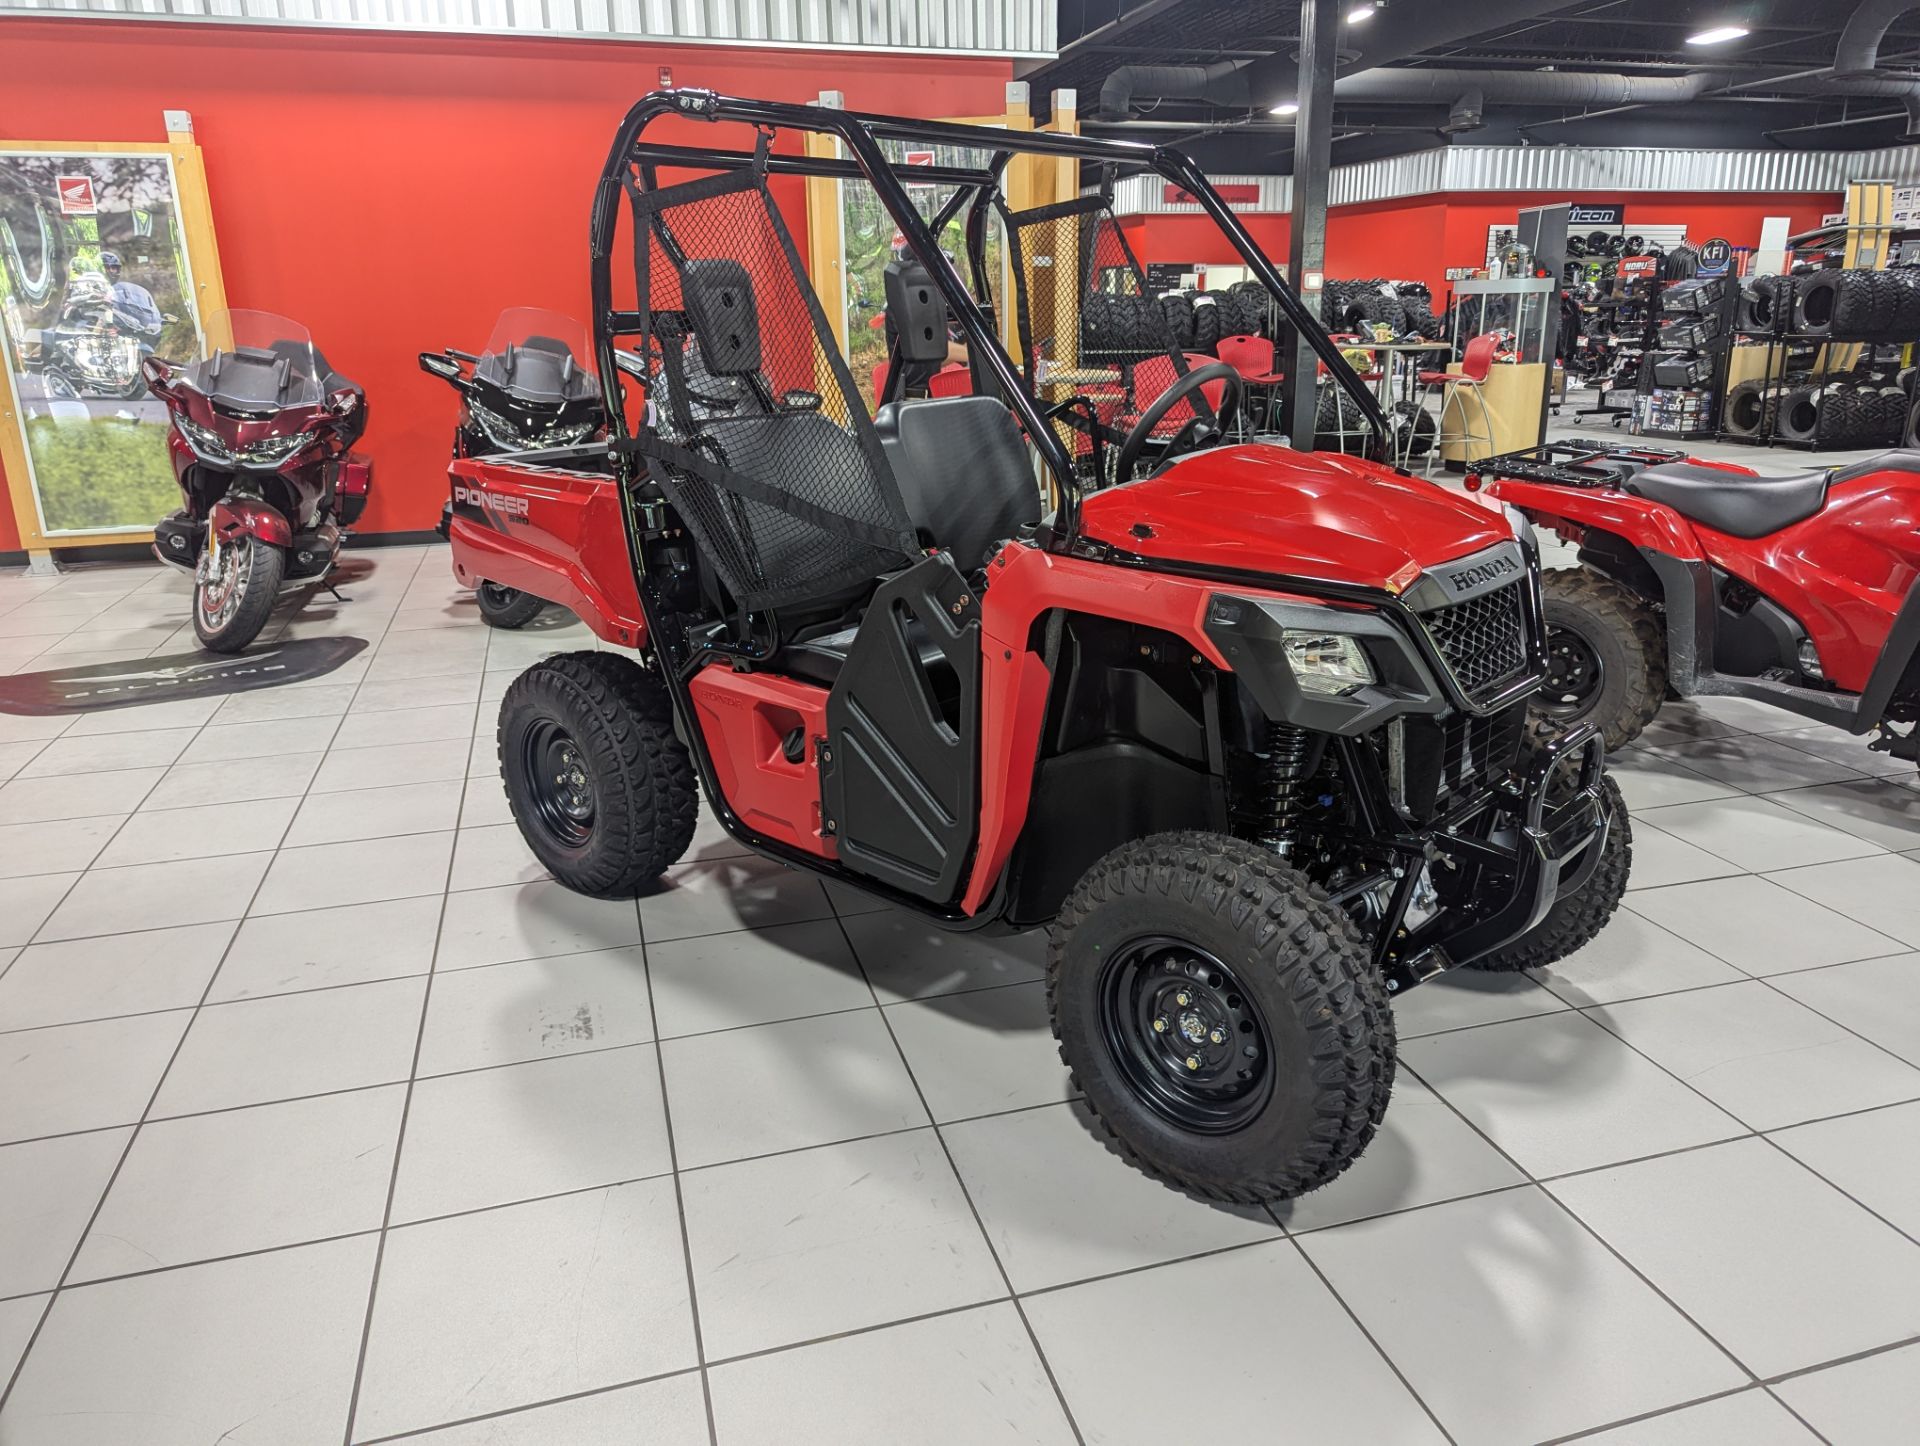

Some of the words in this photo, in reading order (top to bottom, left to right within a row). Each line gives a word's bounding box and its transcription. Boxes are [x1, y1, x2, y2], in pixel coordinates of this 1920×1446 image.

[1703, 246, 1724, 260] KFI
[454, 486, 528, 516] PIONEER
[1449, 556, 1518, 591] HONDA
